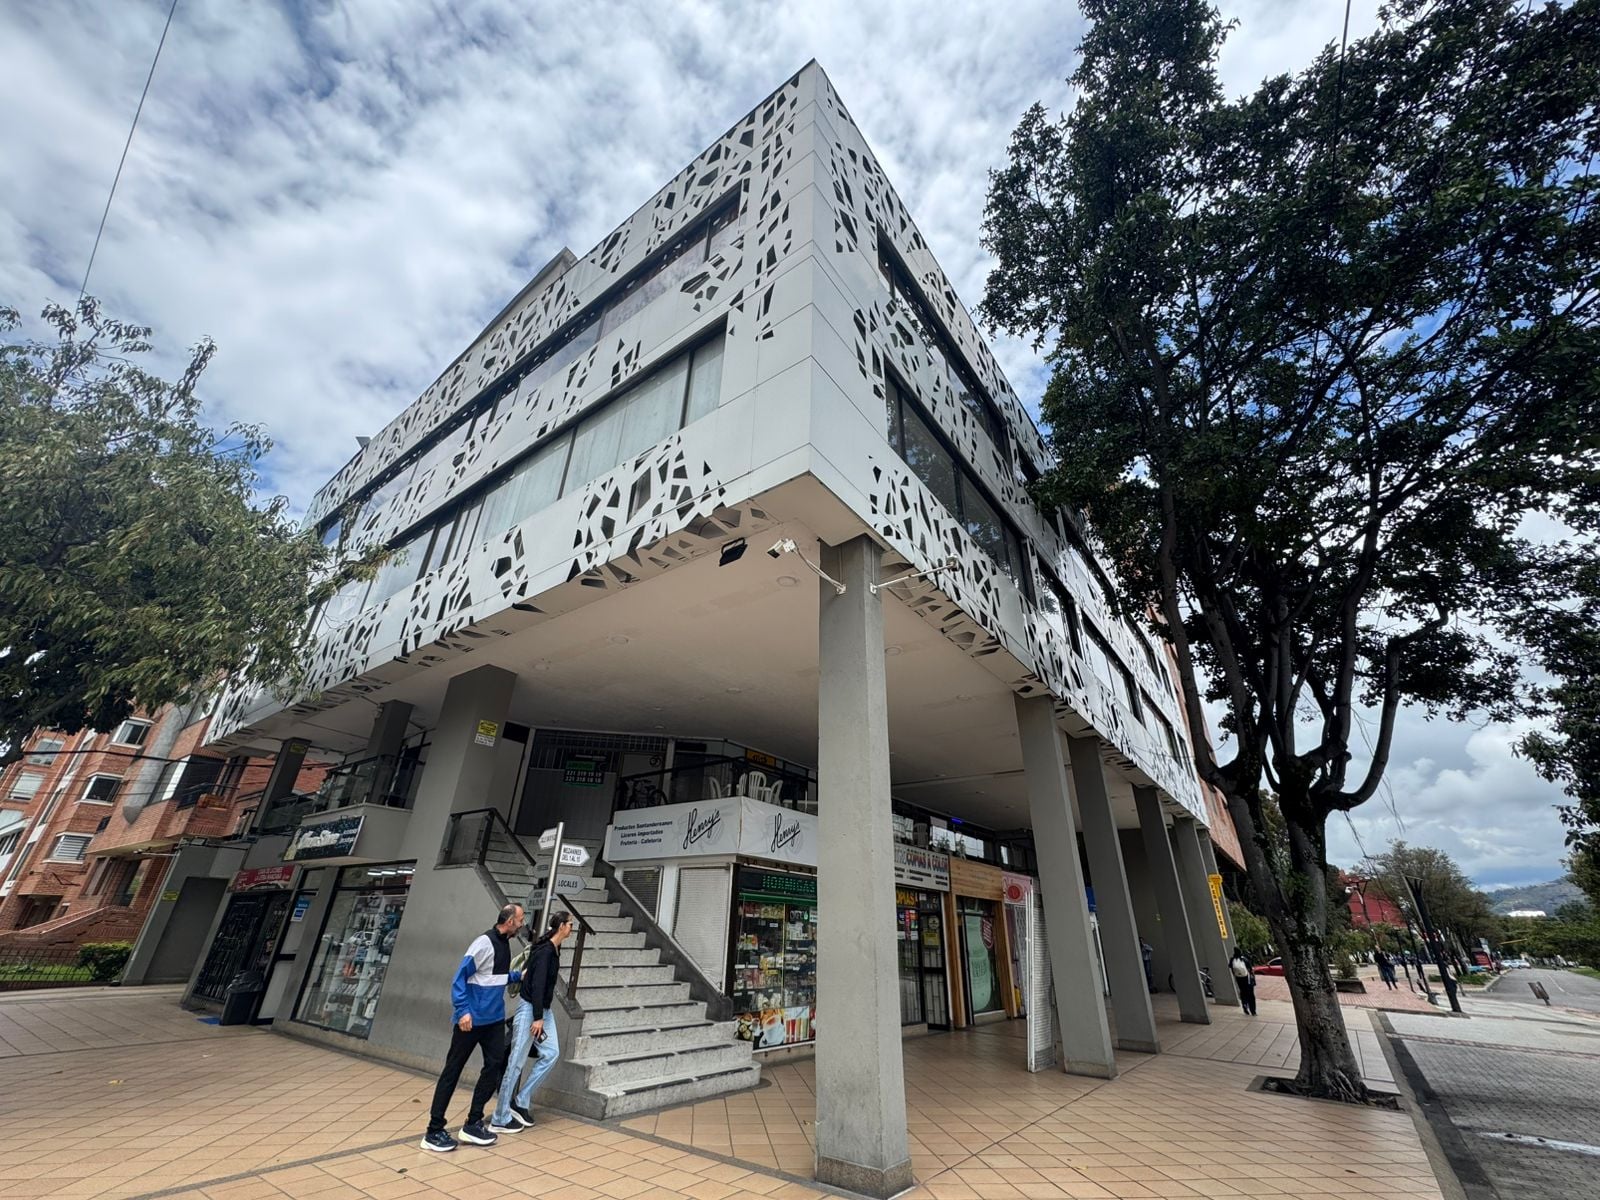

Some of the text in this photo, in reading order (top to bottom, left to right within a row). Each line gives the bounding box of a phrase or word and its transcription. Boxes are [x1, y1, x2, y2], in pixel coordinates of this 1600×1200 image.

[636, 821, 673, 829] Santandereanos
[683, 808, 720, 849] Henry's
[771, 812, 800, 853] Henry's
[557, 880, 578, 888] LOCALES
